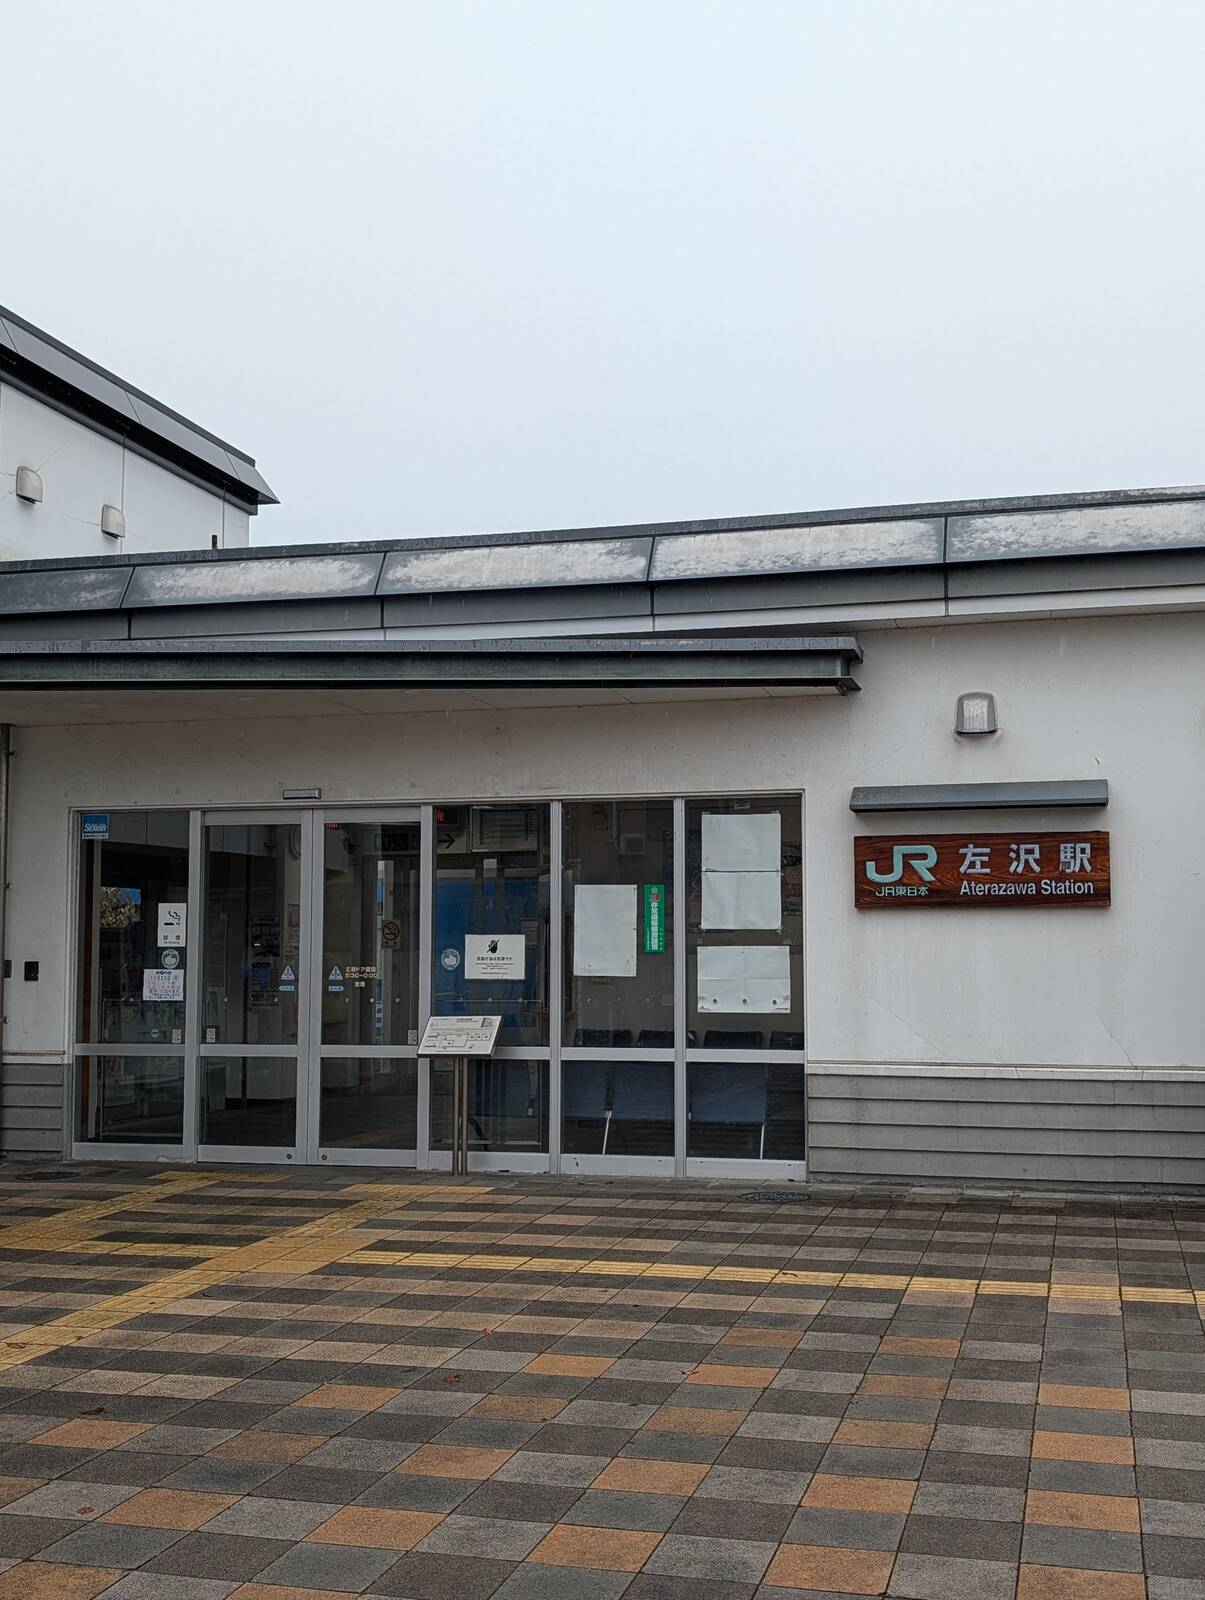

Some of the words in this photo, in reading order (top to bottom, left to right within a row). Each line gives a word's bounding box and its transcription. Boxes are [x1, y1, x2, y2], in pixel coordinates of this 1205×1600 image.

[865, 844, 938, 884] JR
[958, 843, 1093, 875] 左沢駅
[875, 885, 930, 898] JR東日本
[959, 881, 1037, 896] Aterazawa
[1040, 879, 1094, 895] Station
